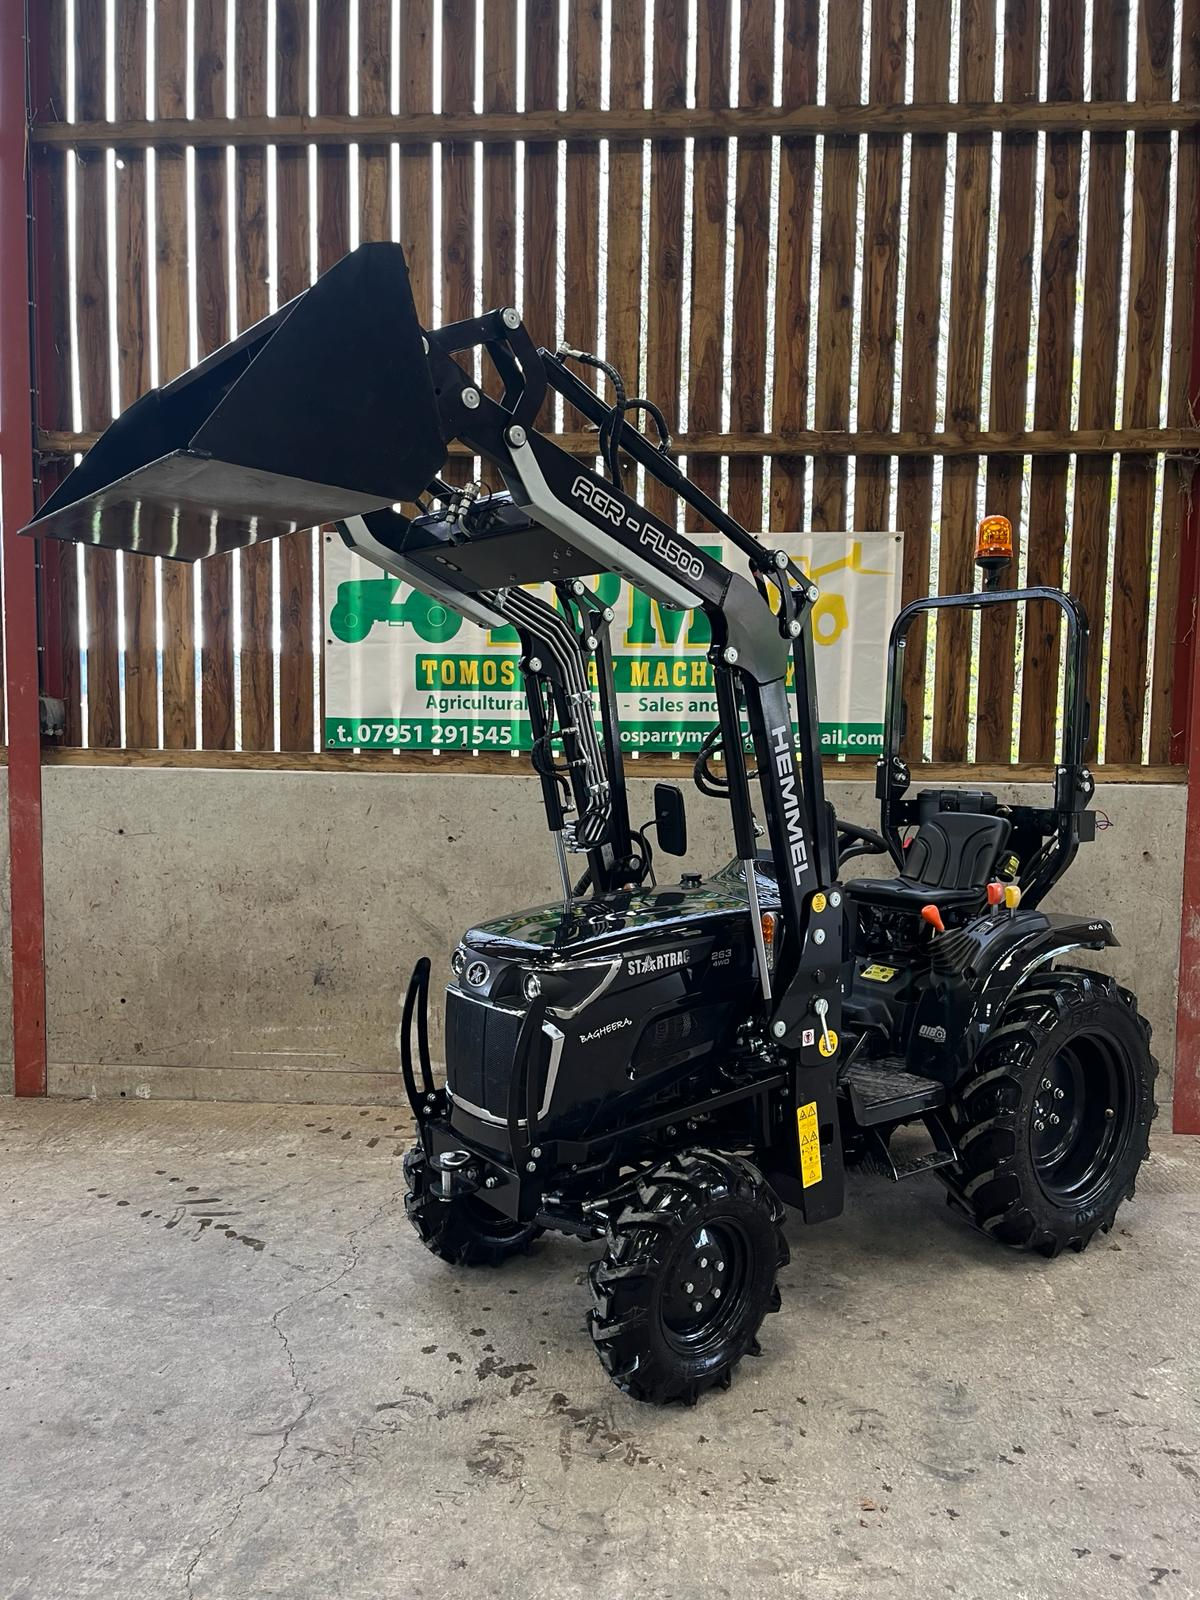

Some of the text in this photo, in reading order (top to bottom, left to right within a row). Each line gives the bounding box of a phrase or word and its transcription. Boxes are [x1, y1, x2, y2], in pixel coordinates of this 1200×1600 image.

[571, 475, 626, 526] AGR
[639, 523, 704, 581] FL500
[421, 659, 515, 685] TOMOS
[425, 695, 528, 713] Agricultural
[638, 696, 684, 712] Sales
[337, 725, 353, 742] t.
[357, 724, 423, 743] 07951
[430, 725, 513, 745] 291545
[771, 725, 809, 886] HEMMEL
[711, 948, 732, 961] 263
